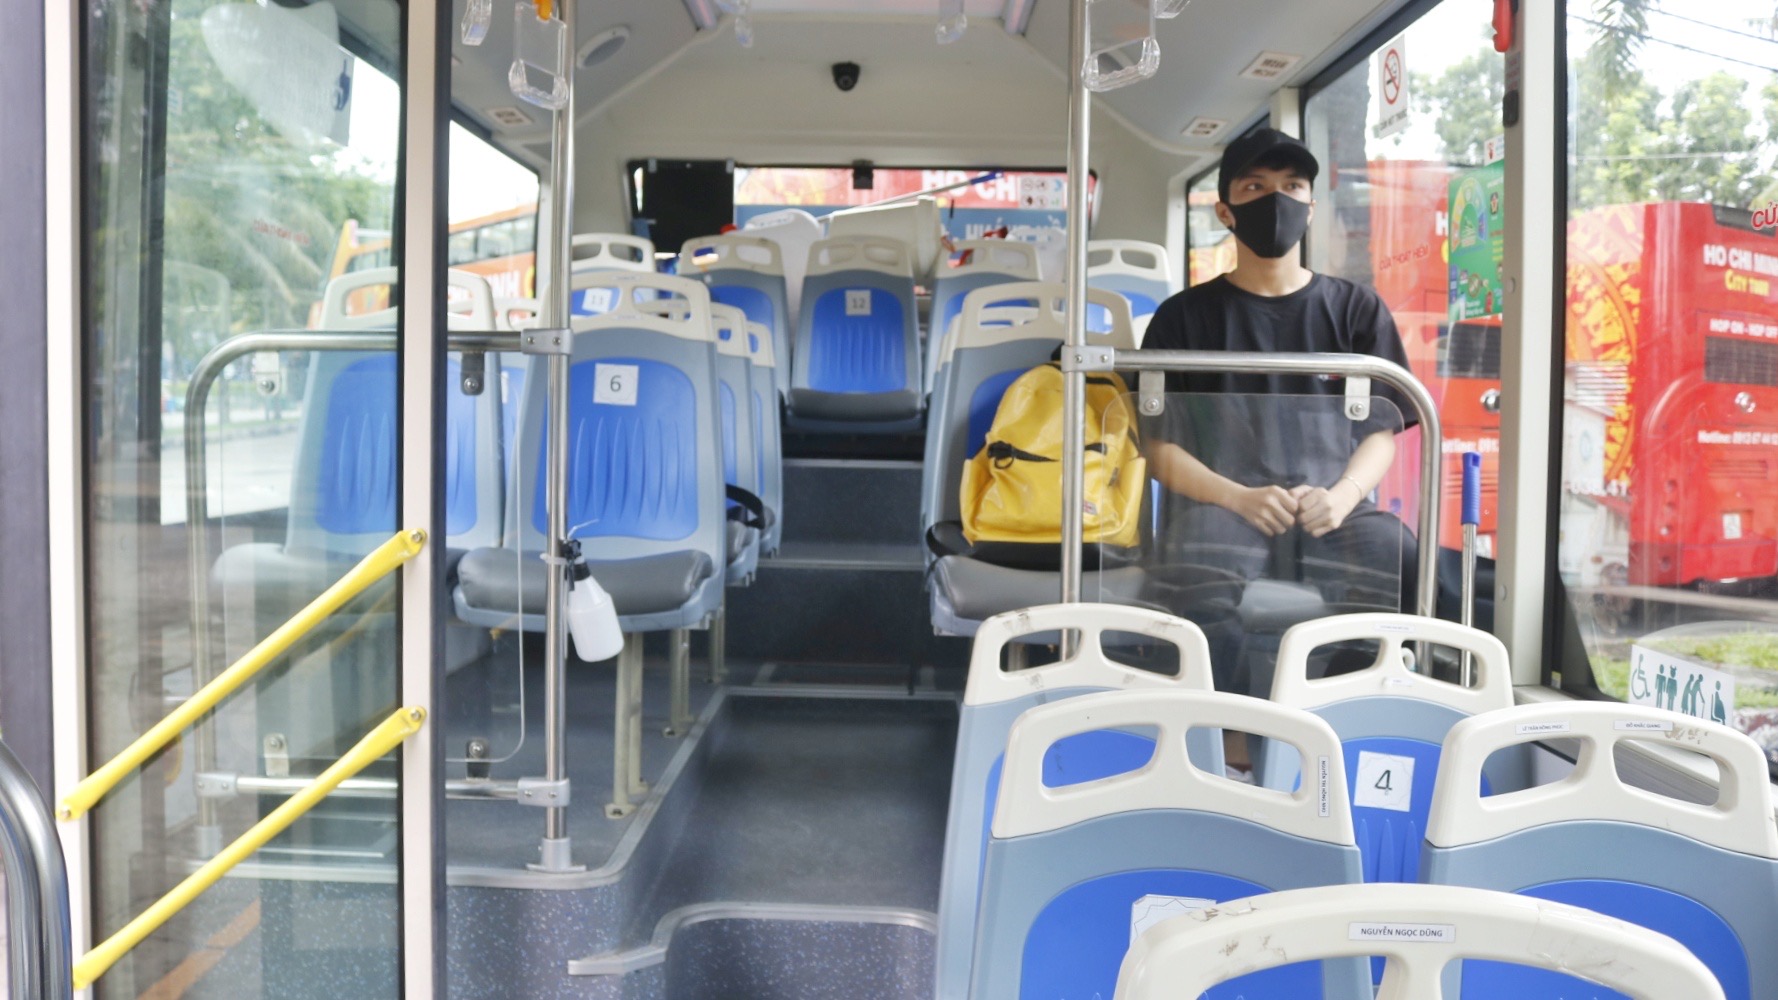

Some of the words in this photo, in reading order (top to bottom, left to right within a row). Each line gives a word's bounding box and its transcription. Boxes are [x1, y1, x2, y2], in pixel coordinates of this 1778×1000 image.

[975, 171, 1017, 202] CH
[1752, 201, 1778, 228] CỬ
[1703, 244, 1727, 267] HO
[1728, 247, 1752, 272] CHI
[853, 297, 866, 309] 12
[610, 375, 622, 392] 6
[1374, 769, 1393, 791] 4
[1360, 925, 1393, 936] NGUYỄN
[1395, 928, 1418, 938] NGỌC
[1419, 928, 1443, 938] DŨNG
